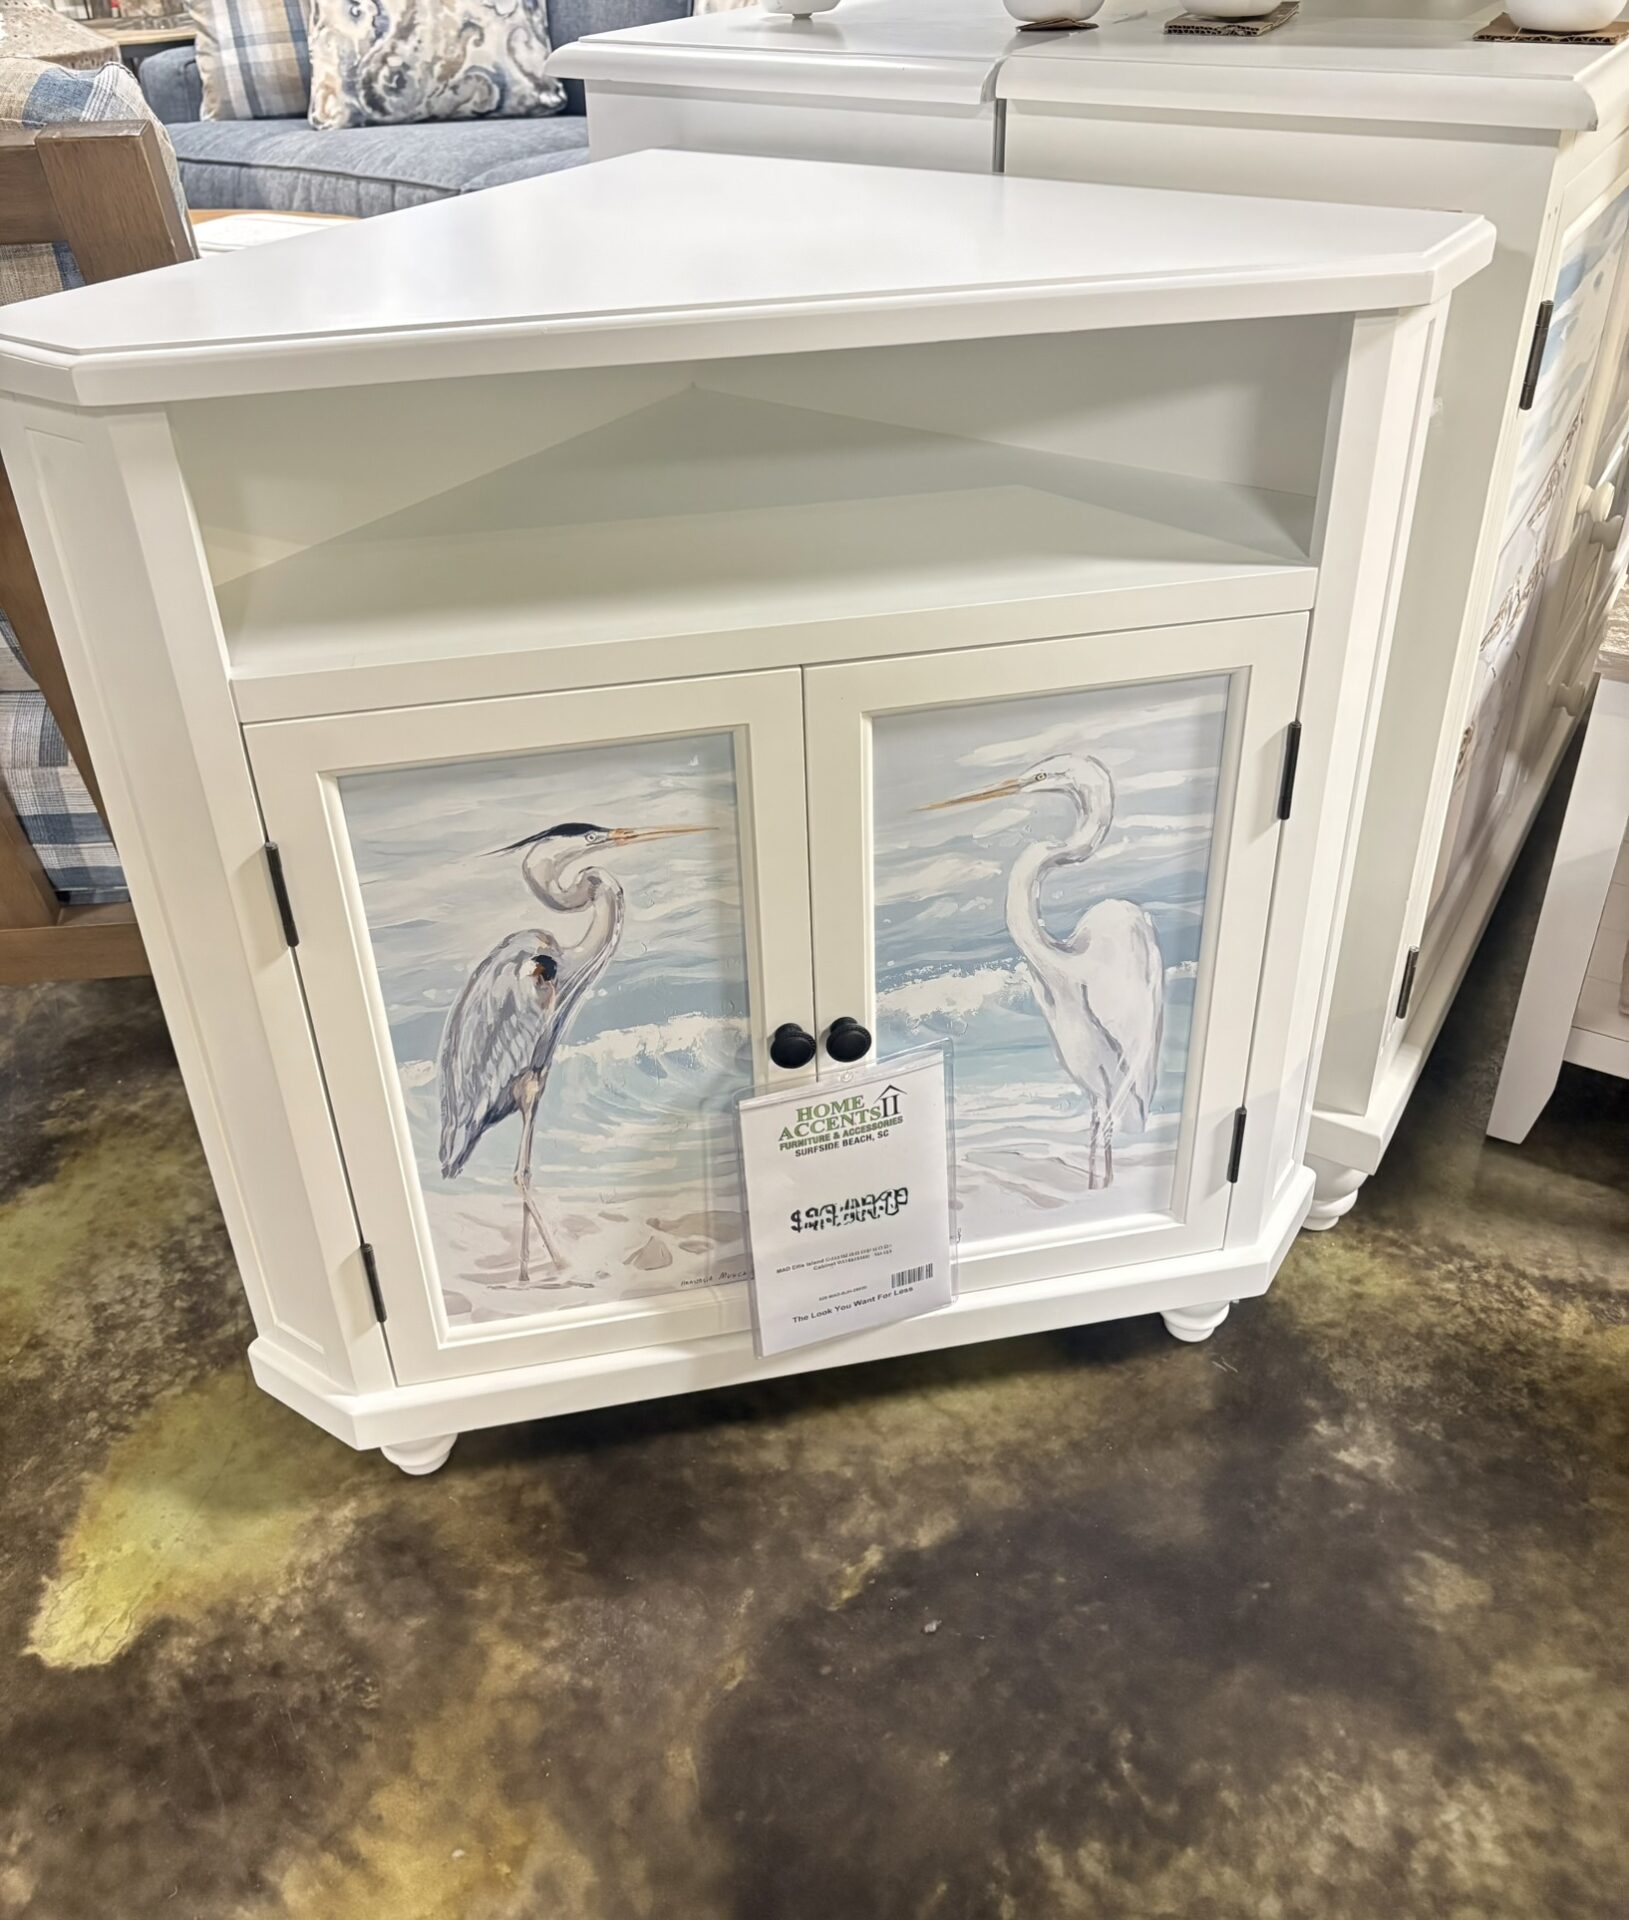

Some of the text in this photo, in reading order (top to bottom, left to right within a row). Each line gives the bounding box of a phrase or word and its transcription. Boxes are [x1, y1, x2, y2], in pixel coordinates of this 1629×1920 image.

[778, 1106, 882, 1141] ACCENTS
[795, 1095, 865, 1122] HOME
[779, 1116, 903, 1151] FURNITURE & ACCESSORIES
[795, 1129, 889, 1157] SURFSIDE BEACH, SC
[792, 1314, 809, 1323] The
[811, 1308, 833, 1319] Look
[834, 1303, 852, 1312] You
[853, 1296, 876, 1307] Want
[877, 1291, 892, 1300] For
[893, 1286, 914, 1296] Less
